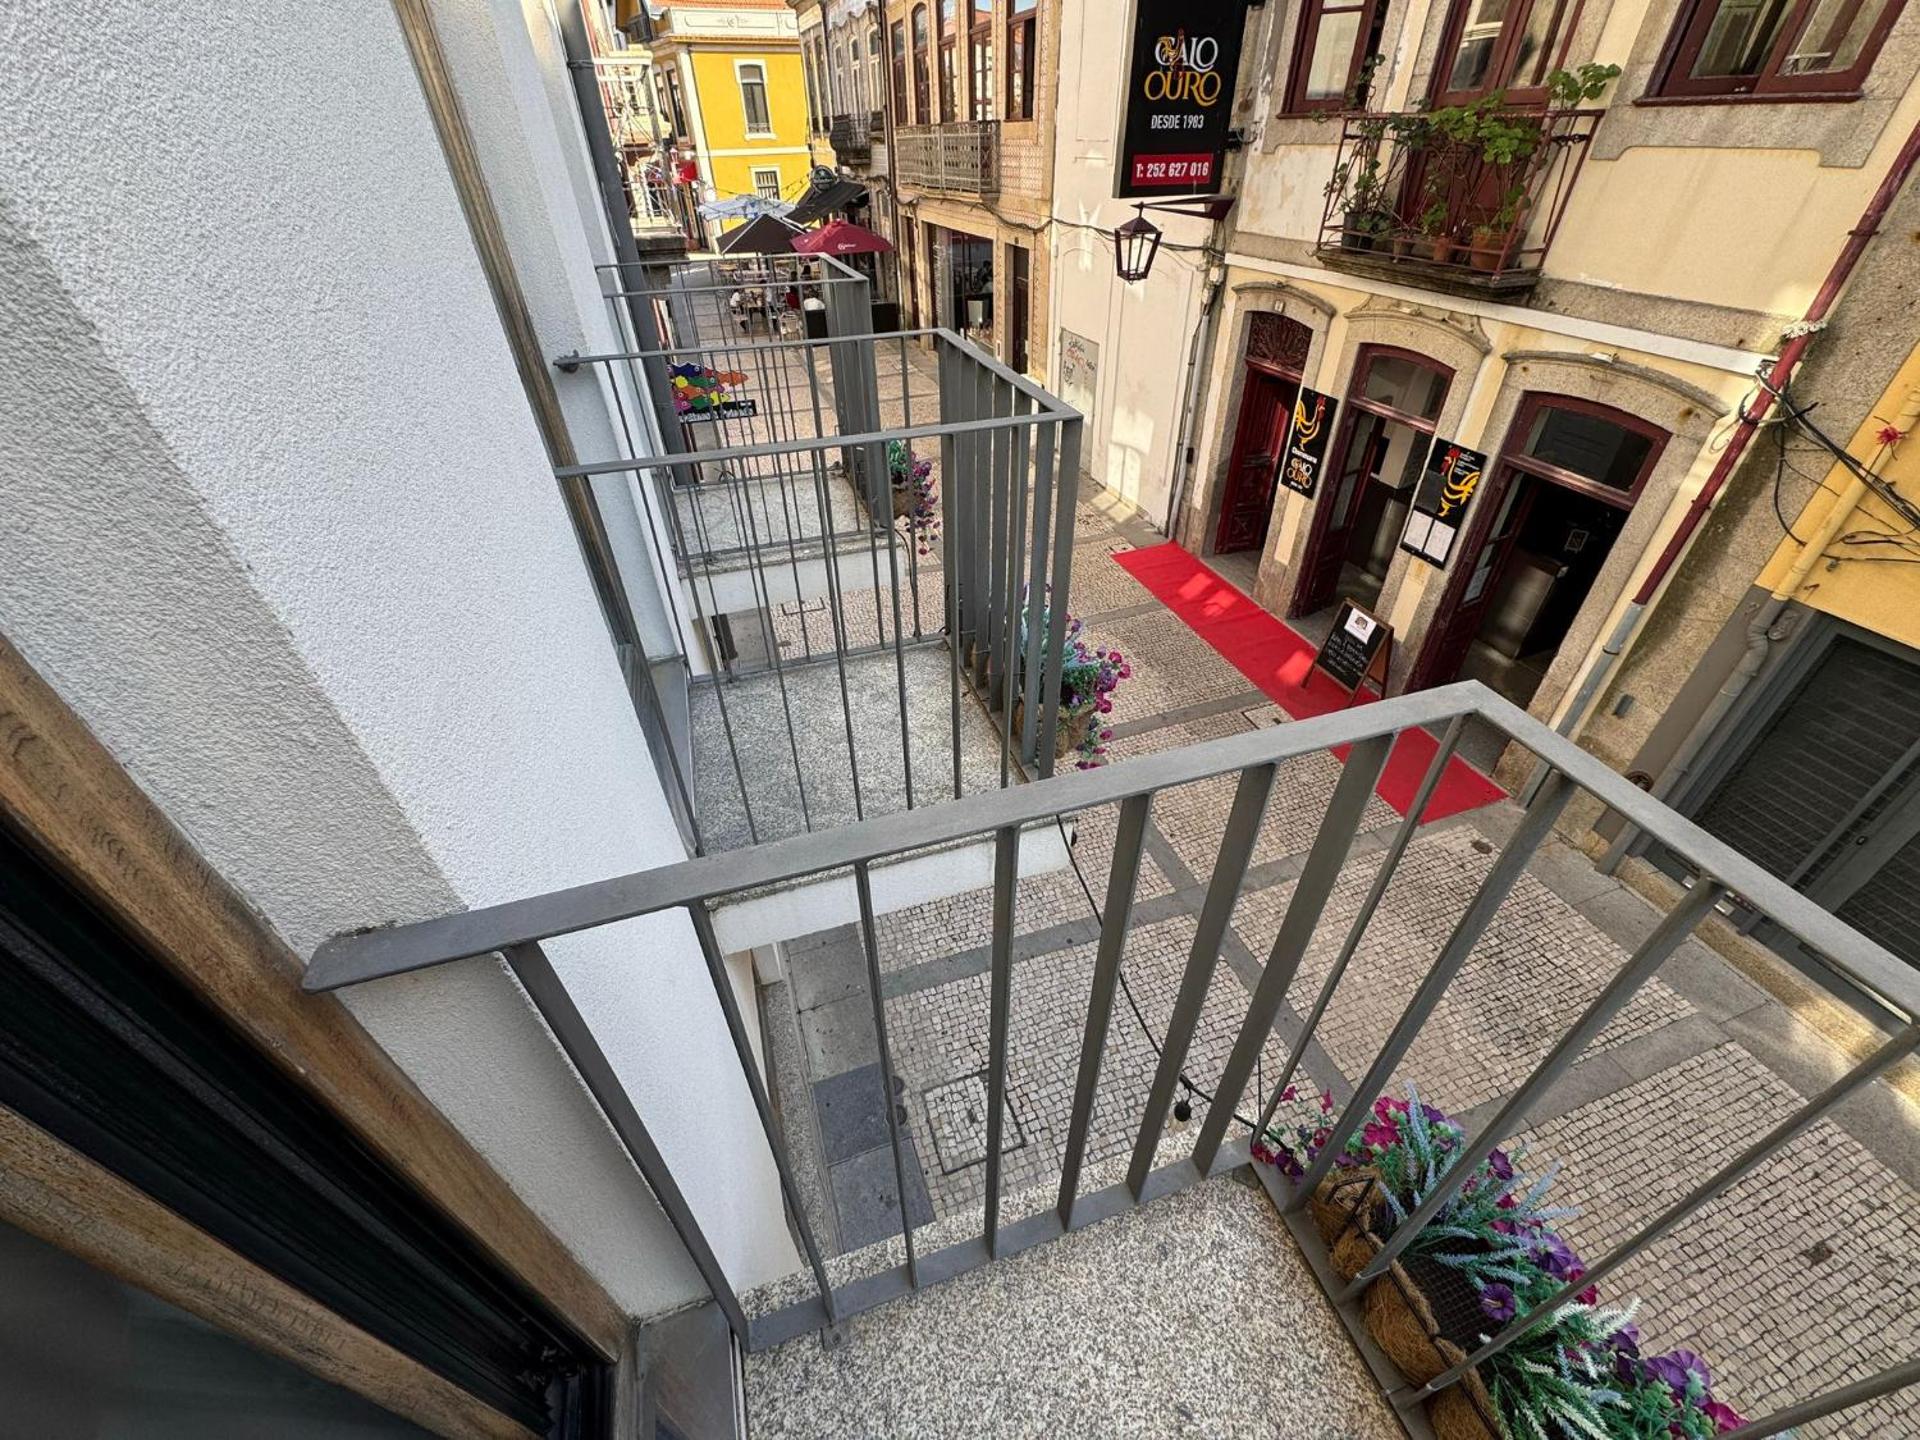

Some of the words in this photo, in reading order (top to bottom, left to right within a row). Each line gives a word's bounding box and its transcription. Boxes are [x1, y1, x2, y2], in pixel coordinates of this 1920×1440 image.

[1144, 71, 1221, 106] OURO
[1151, 114, 1180, 129] DESDE
[1183, 114, 1204, 129] 1983
[1136, 163, 1144, 178] T:
[1146, 163, 1166, 178] 252
[1168, 162, 1188, 178] 627
[1190, 161, 1209, 177] 016
